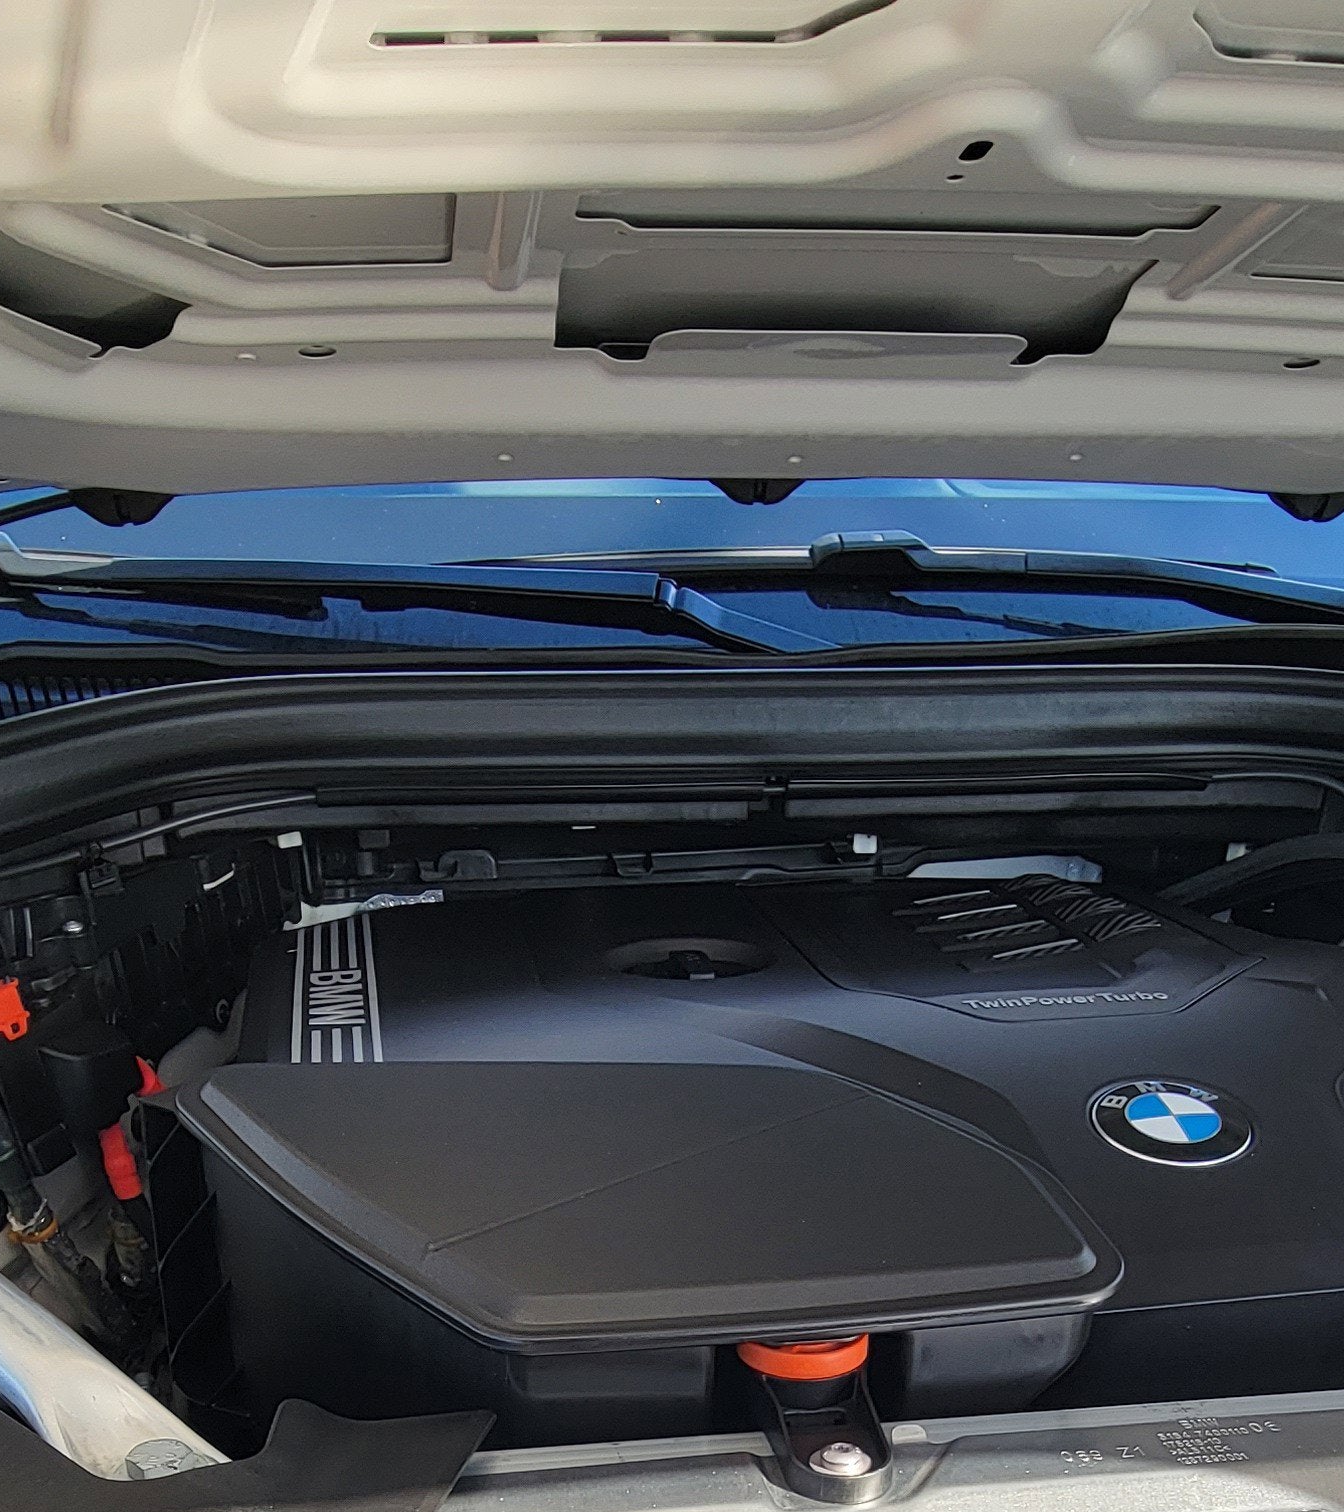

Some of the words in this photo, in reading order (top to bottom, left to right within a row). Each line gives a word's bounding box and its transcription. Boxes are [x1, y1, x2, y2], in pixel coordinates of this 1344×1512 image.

[309, 969, 366, 1025] BMW
[1095, 991, 1169, 1003] Turbo
[1101, 1080, 1219, 1109] BMW
